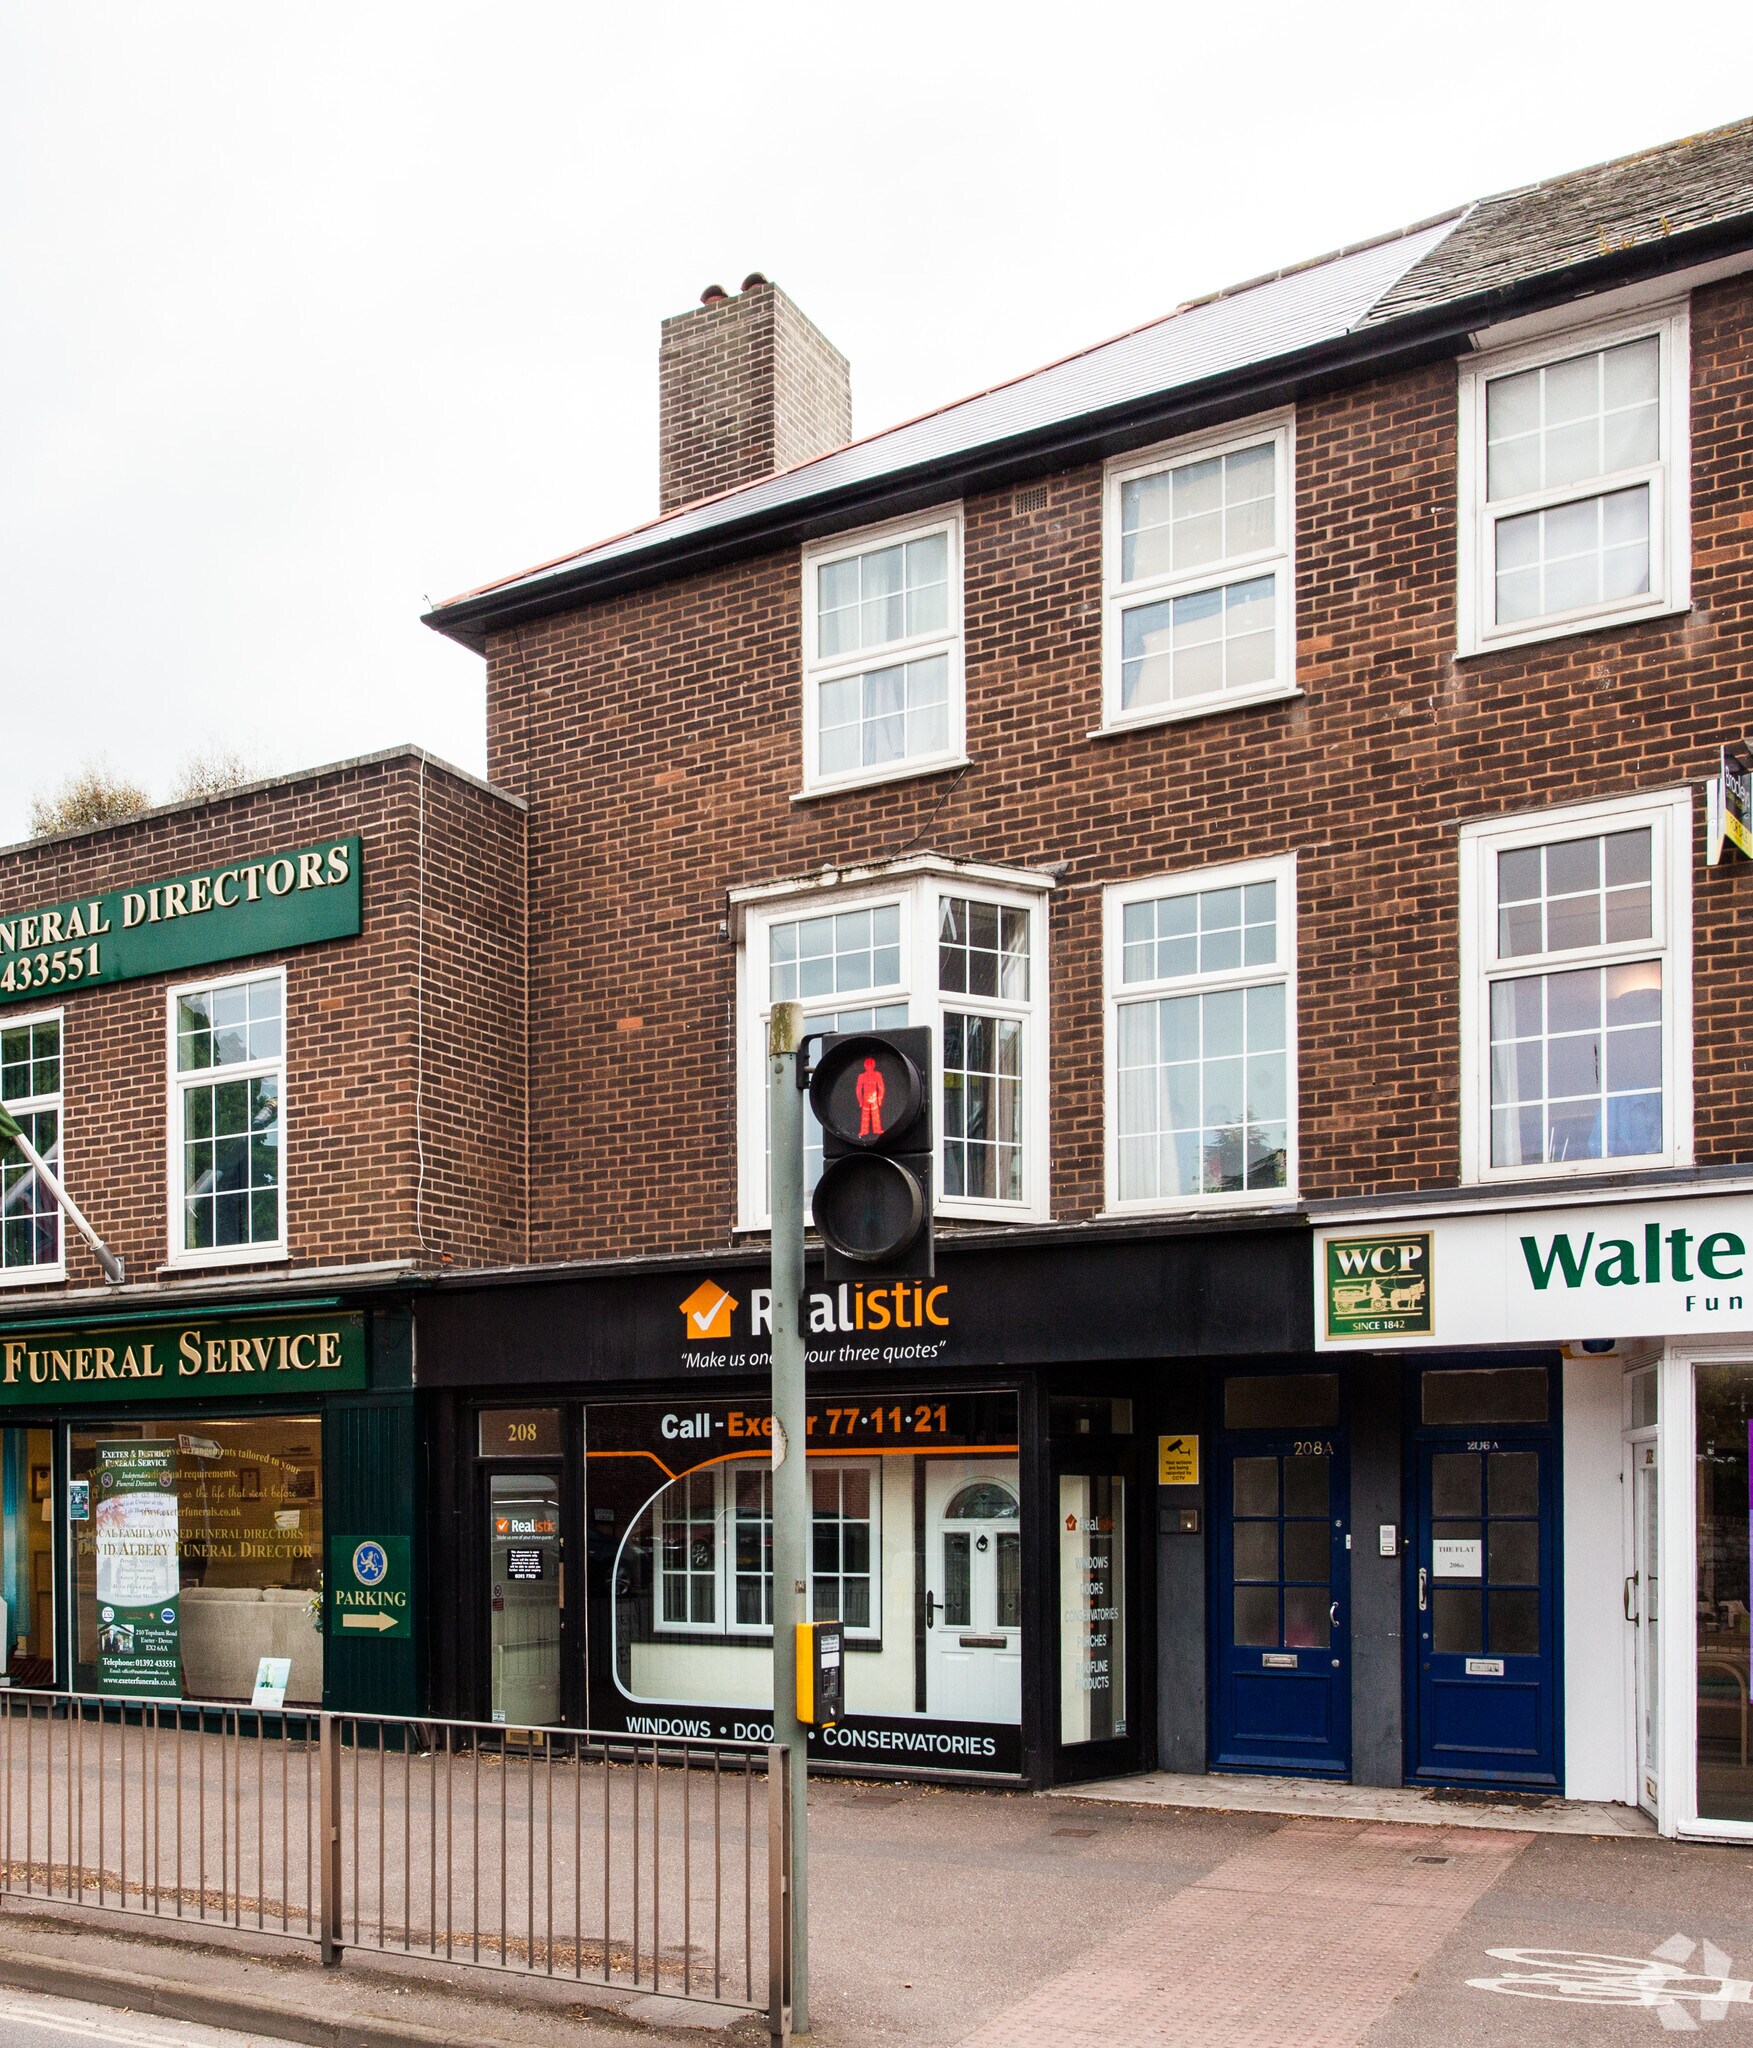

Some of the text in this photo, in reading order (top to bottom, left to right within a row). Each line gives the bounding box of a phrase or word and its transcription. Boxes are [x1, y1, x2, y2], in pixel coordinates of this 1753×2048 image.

[122, 845, 349, 929] DIRECTORS
[0, 943, 101, 992] 433551
[1334, 1244, 1423, 1276] WCP
[1519, 1222, 1746, 1290] Walte
[751, 1281, 950, 1336] Ralistic
[1686, 1294, 1744, 1312] Fun
[1353, 1318, 1406, 1331] SINCE 1842
[2, 1330, 343, 1384] FUNERAL SERVICE
[729, 1355, 745, 1367] us
[838, 1346, 878, 1362] three
[507, 1423, 538, 1442] 208
[661, 1413, 710, 1440] Call
[728, 1411, 817, 1438] Exer
[102, 1449, 129, 1459] EXETER
[130, 1449, 137, 1459] &
[1294, 1441, 1334, 1455] 208A
[138, 1459, 168, 1467] SERVICE
[238, 1449, 270, 1463] tailored
[271, 1456, 279, 1467] to
[280, 1460, 301, 1474] your
[184, 1469, 238, 1480] requirements.
[196, 1486, 208, 1498] the
[211, 1484, 225, 1503] life
[228, 1485, 245, 1498] that
[249, 1488, 268, 1498] went
[271, 1484, 297, 1501] before
[195, 1528, 241, 1538] FUNERAL
[244, 1529, 304, 1539] DIRECTORS
[511, 1519, 556, 1532] Realistic
[119, 1541, 170, 1556] ALBERY
[175, 1541, 236, 1557] FUNERAL
[240, 1542, 313, 1558] DIRECTOR
[1075, 1556, 1108, 1569] WINDOWS
[1080, 1582, 1104, 1595] DOORS
[335, 1591, 407, 1606] PARKING
[1065, 1607, 1119, 1622] CONSERVATORIES
[102, 1658, 176, 1668] Telephone: 01392 433551
[103, 1677, 177, 1686] www.exeterfunerals.co.uk
[1075, 1676, 1109, 1690] PRODUCTS
[626, 1717, 997, 1756] WINDOWS DOO CONSERVATORIES
